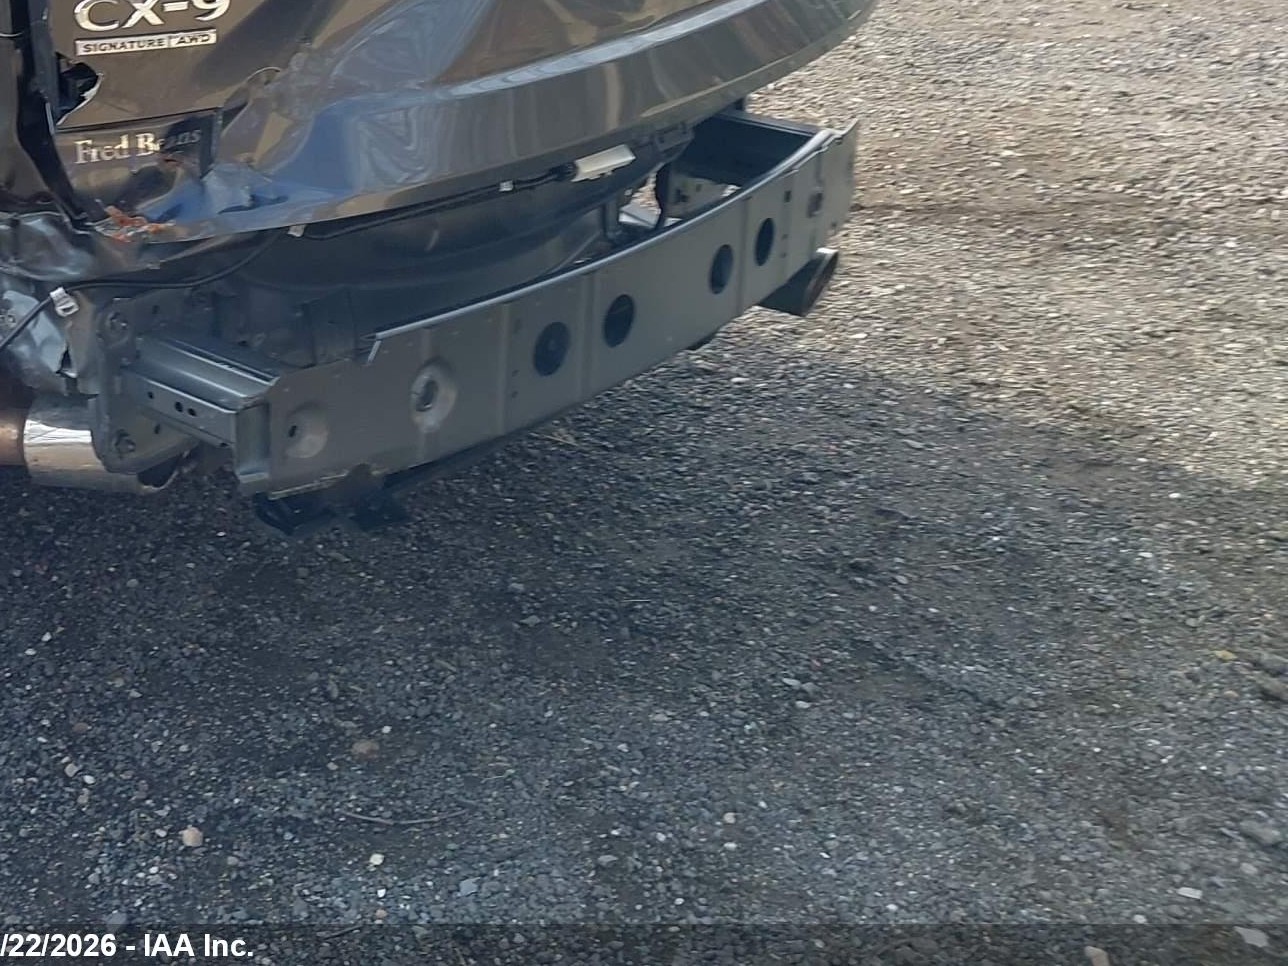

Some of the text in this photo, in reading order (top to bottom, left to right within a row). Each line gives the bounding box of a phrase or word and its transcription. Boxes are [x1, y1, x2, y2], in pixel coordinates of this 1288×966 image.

[83, 32, 212, 53] SIGNATURE AWD
[73, 133, 130, 164] Fred
